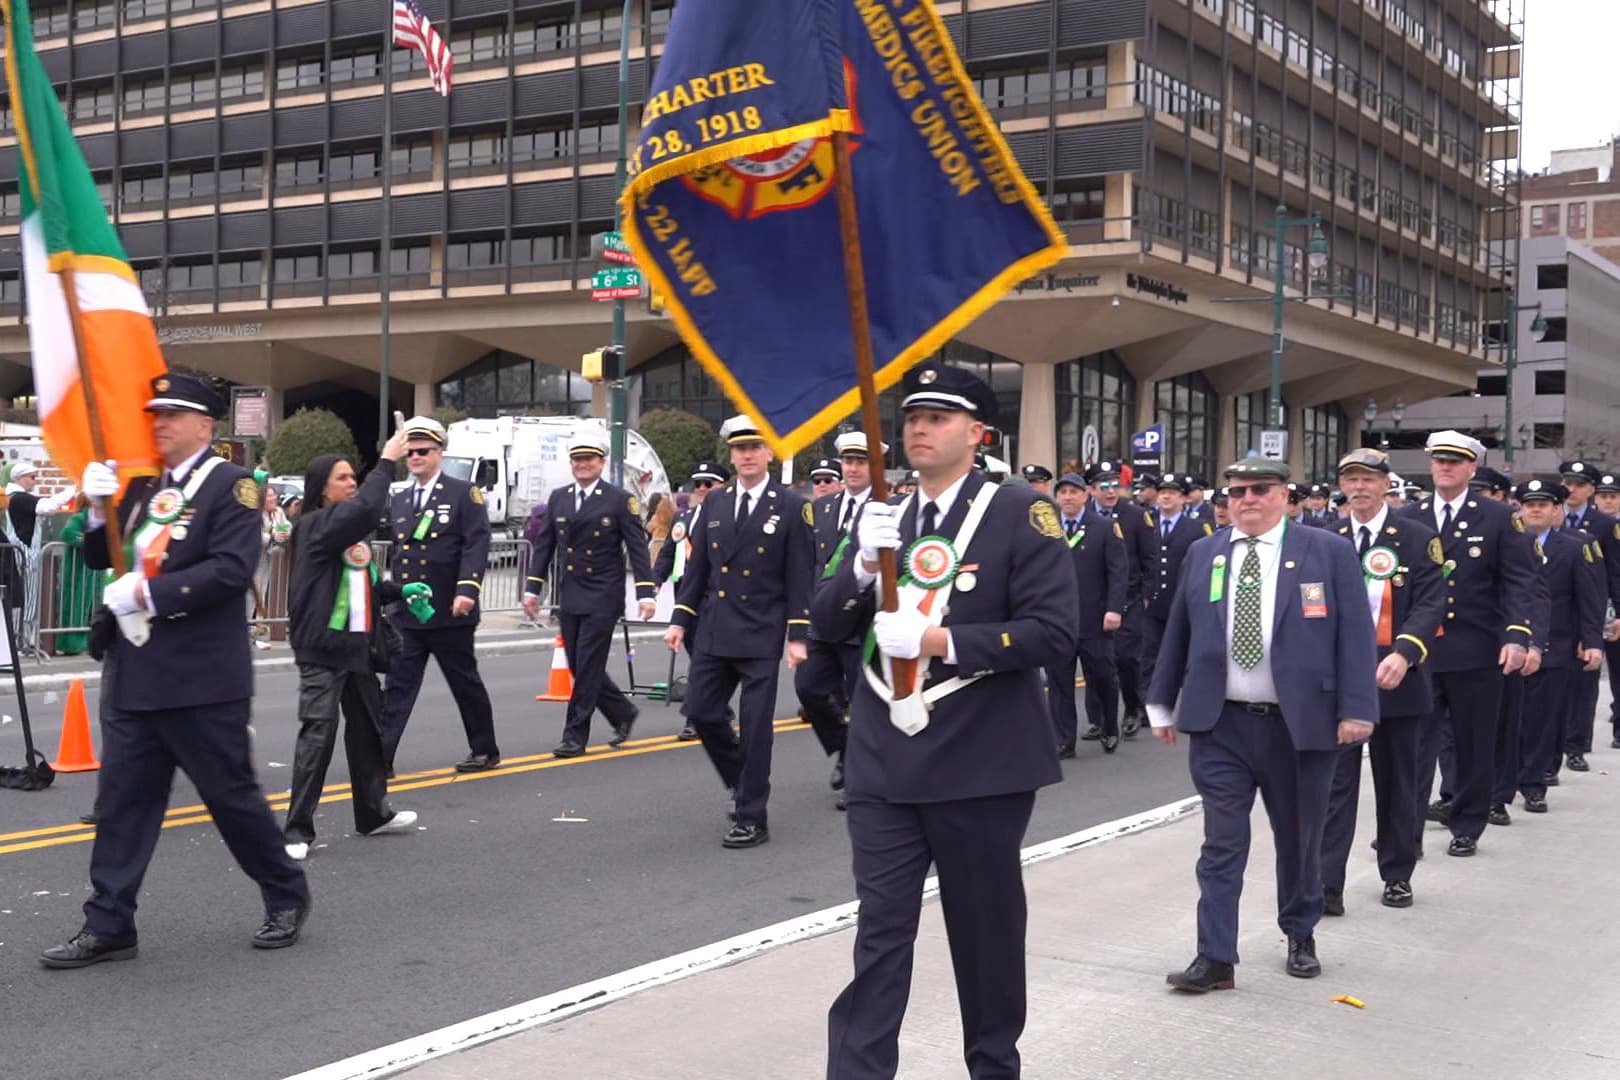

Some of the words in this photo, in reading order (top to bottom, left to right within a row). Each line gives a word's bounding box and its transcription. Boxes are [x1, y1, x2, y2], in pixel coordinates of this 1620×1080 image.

[646, 129, 693, 161] 28,
[696, 105, 762, 143] 1918
[911, 98, 982, 197] UNION
[644, 204, 679, 242] 22
[626, 274, 638, 287] St
[1145, 431, 1160, 449] P
